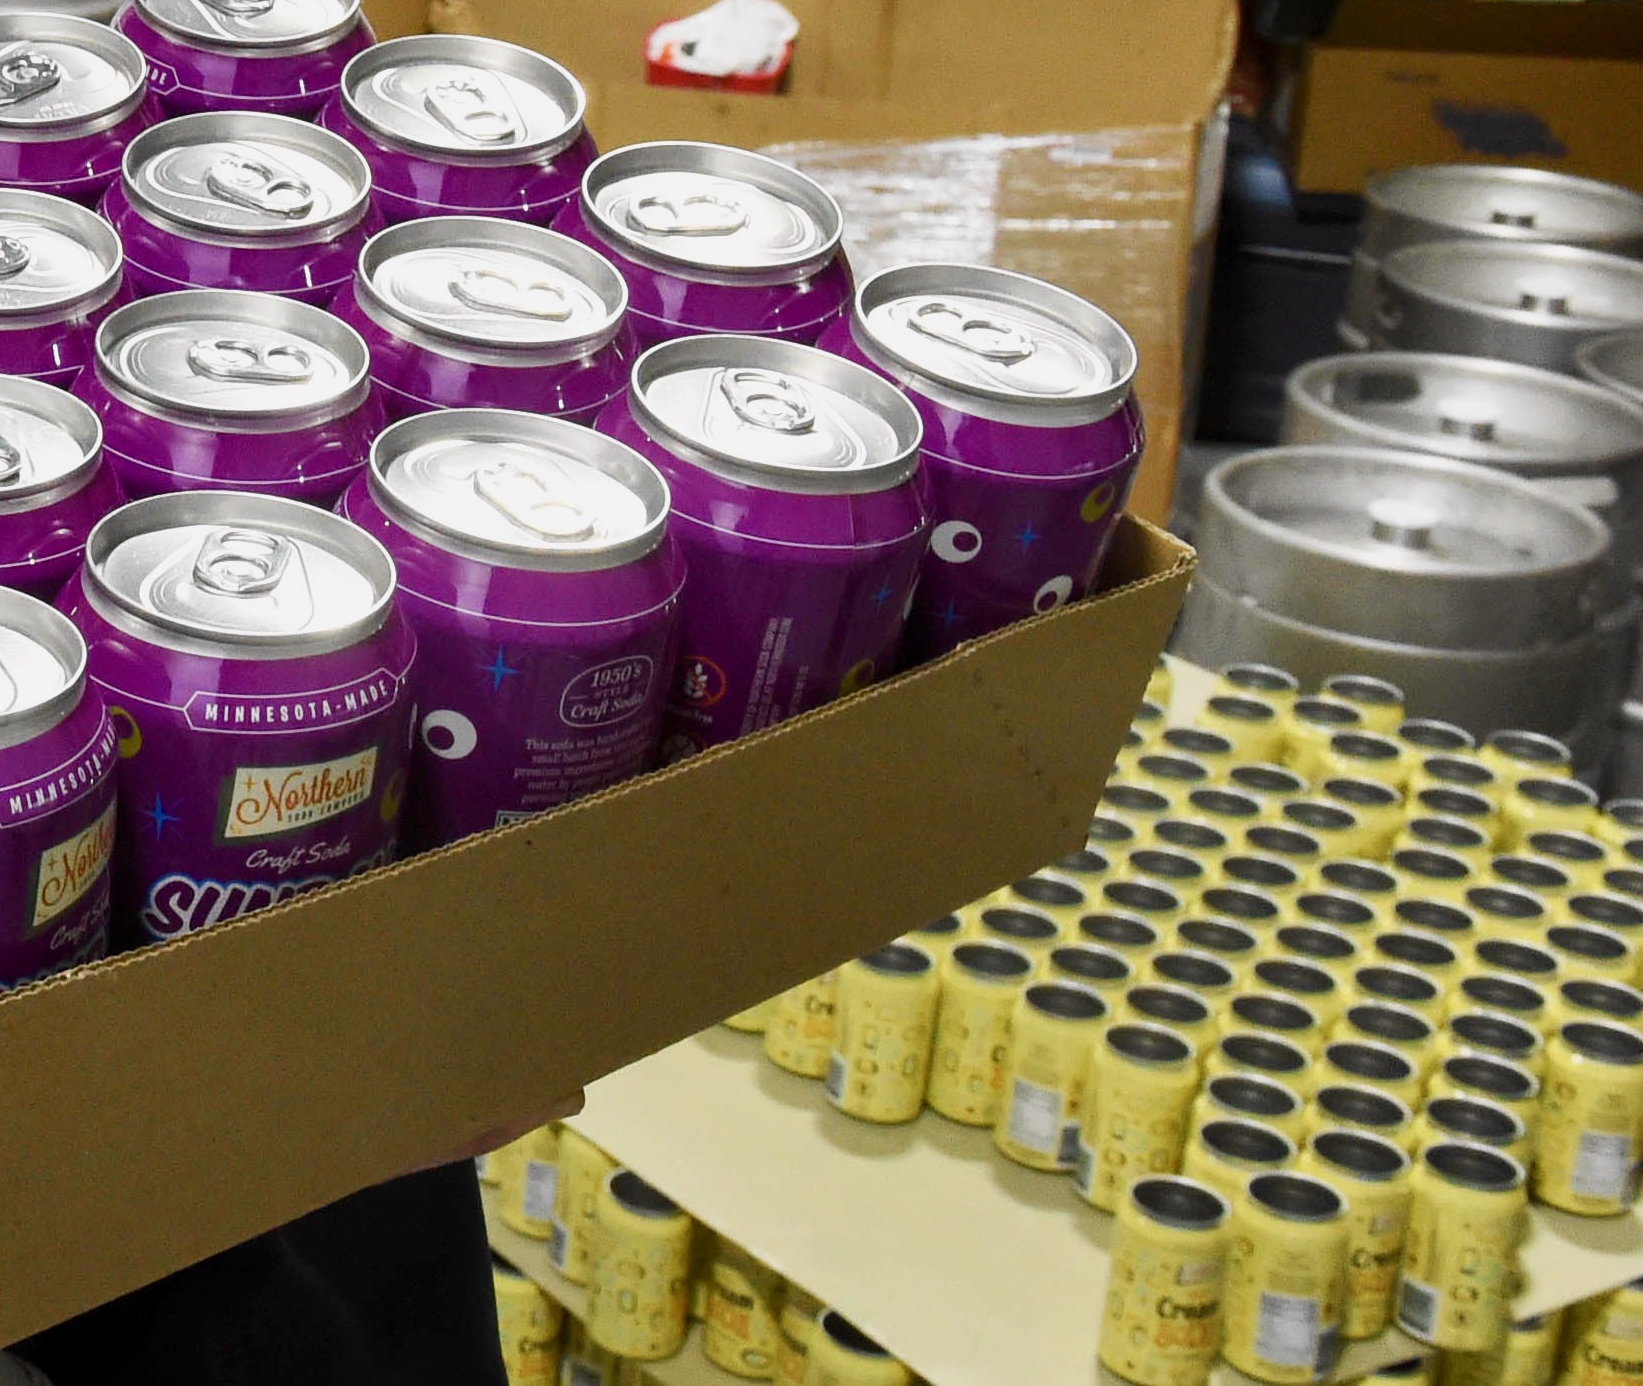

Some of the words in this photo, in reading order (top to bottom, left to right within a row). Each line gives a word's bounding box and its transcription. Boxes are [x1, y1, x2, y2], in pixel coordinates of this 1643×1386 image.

[589, 661, 644, 689] 1950's
[204, 679, 388, 723] MINNESOTA-MADE
[570, 700, 609, 721] Craft
[611, 692, 646, 713] Soda
[235, 767, 369, 826] Northern
[245, 847, 305, 874] Craft
[306, 833, 352, 864] Soda
